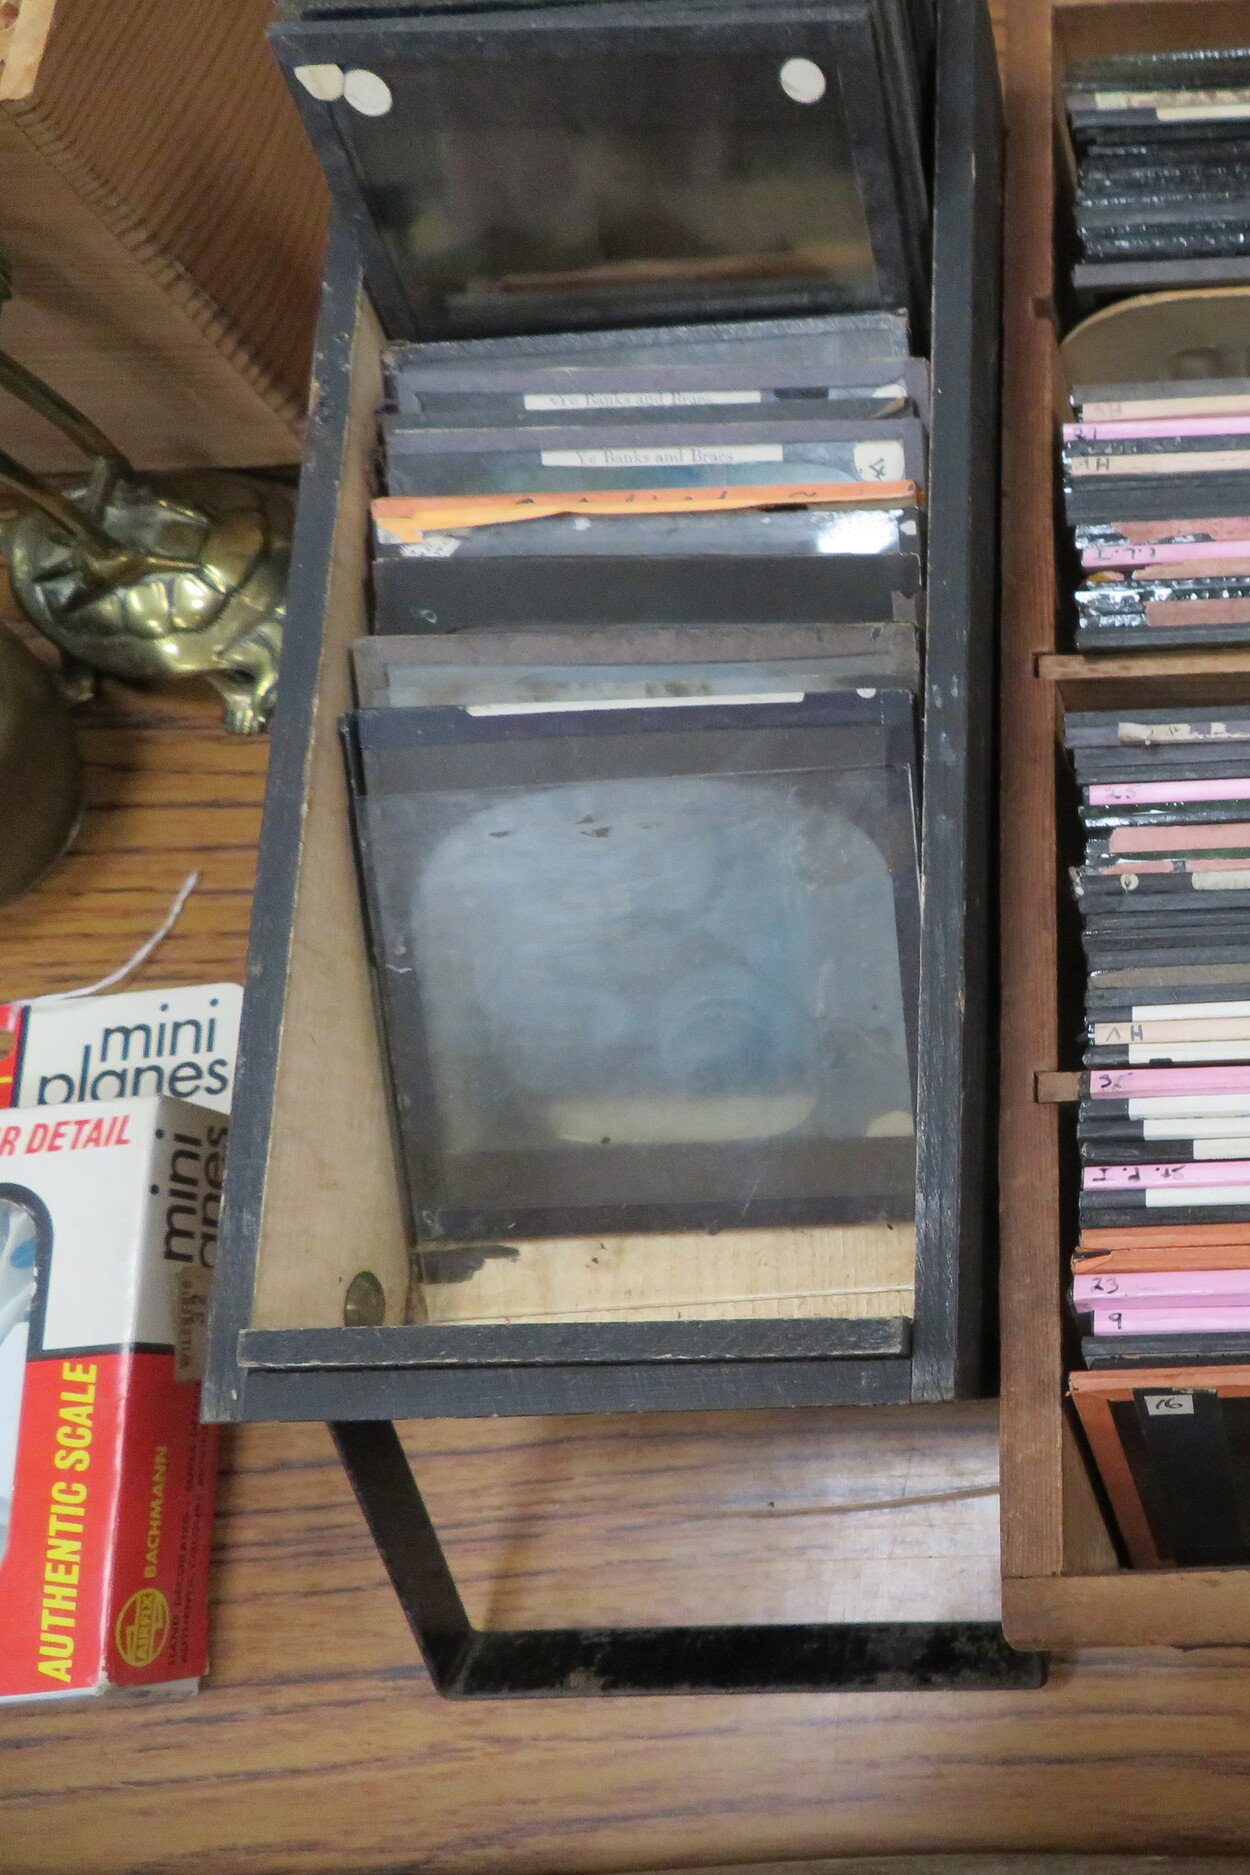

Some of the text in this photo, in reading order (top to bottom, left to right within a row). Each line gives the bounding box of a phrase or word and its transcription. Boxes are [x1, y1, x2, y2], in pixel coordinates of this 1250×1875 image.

[603, 449, 650, 464] Banks
[655, 449, 683, 463] and
[101, 998, 220, 1063] mini
[24, 1114, 131, 1155] DETAIL
[150, 1128, 203, 1263] mini
[37, 1361, 98, 1683] AUTHENTIC SCALE
[144, 1446, 168, 1579] BACHMANN
